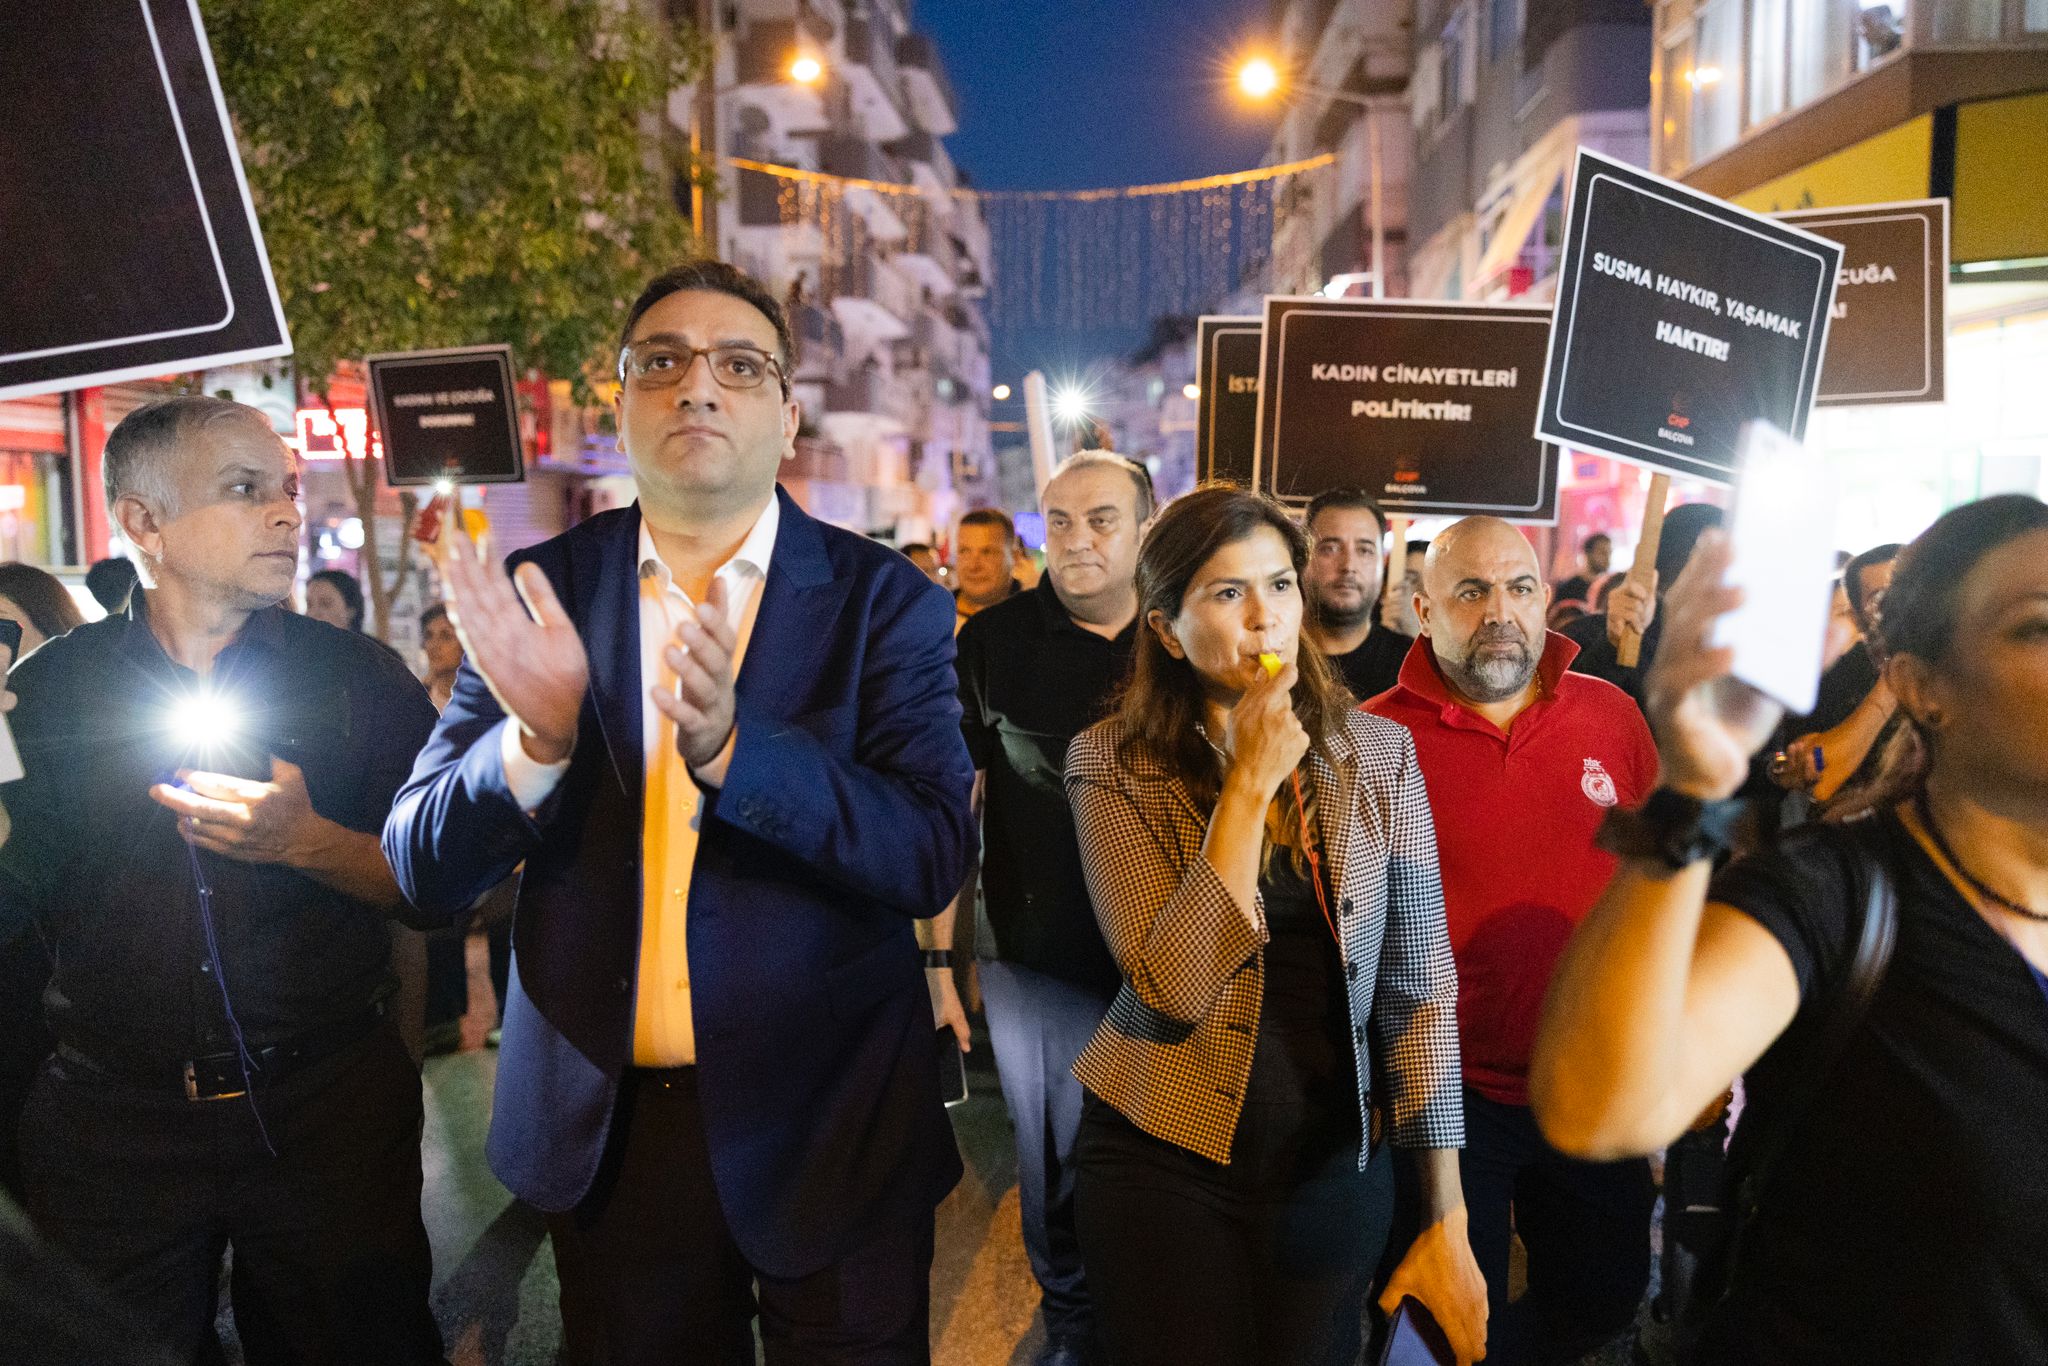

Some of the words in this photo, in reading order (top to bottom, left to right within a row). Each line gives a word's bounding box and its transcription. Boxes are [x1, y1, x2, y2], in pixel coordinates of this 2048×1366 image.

[1838, 262, 1898, 286] CUĞA
[1592, 251, 1653, 290] SUSMA
[1655, 273, 1721, 316] HAYKIR,
[1725, 297, 1802, 340] YAŞAMAK
[1655, 320, 1730, 362] HAKTIR!
[1311, 362, 1378, 382] KADIN
[1382, 362, 1518, 388] CİNAYETLERİ
[1351, 398, 1472, 422] POLİTİKTİR!
